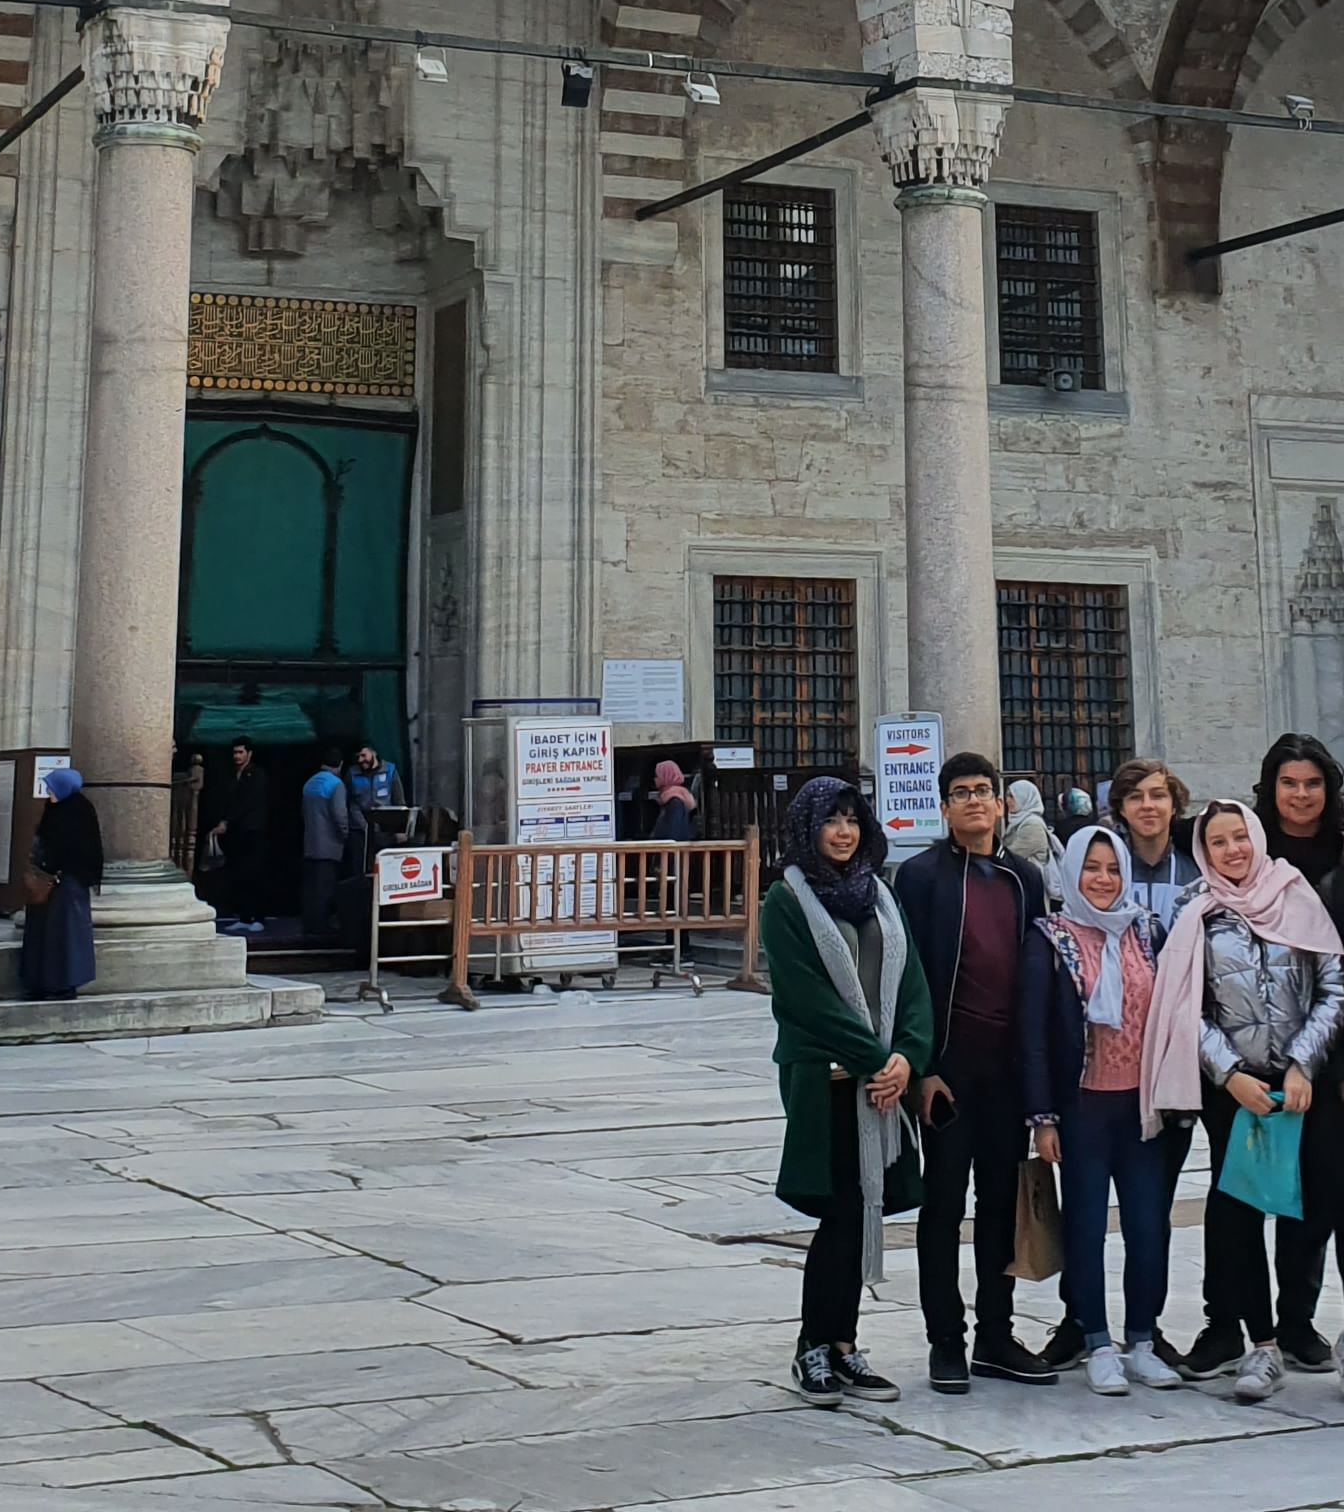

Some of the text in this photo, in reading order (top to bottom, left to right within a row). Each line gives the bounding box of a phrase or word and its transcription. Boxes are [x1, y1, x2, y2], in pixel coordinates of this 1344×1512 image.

[530, 732, 598, 745] İBADET İÇİN
[887, 728, 931, 740] VISITORS
[529, 746, 599, 759] GİRİŞ KAPISI
[525, 759, 603, 773] PRAYER ENTRANCE
[884, 762, 935, 776] ENTRANCE
[889, 779, 932, 793] EINGANG
[886, 797, 936, 811] L'ENTRATA
